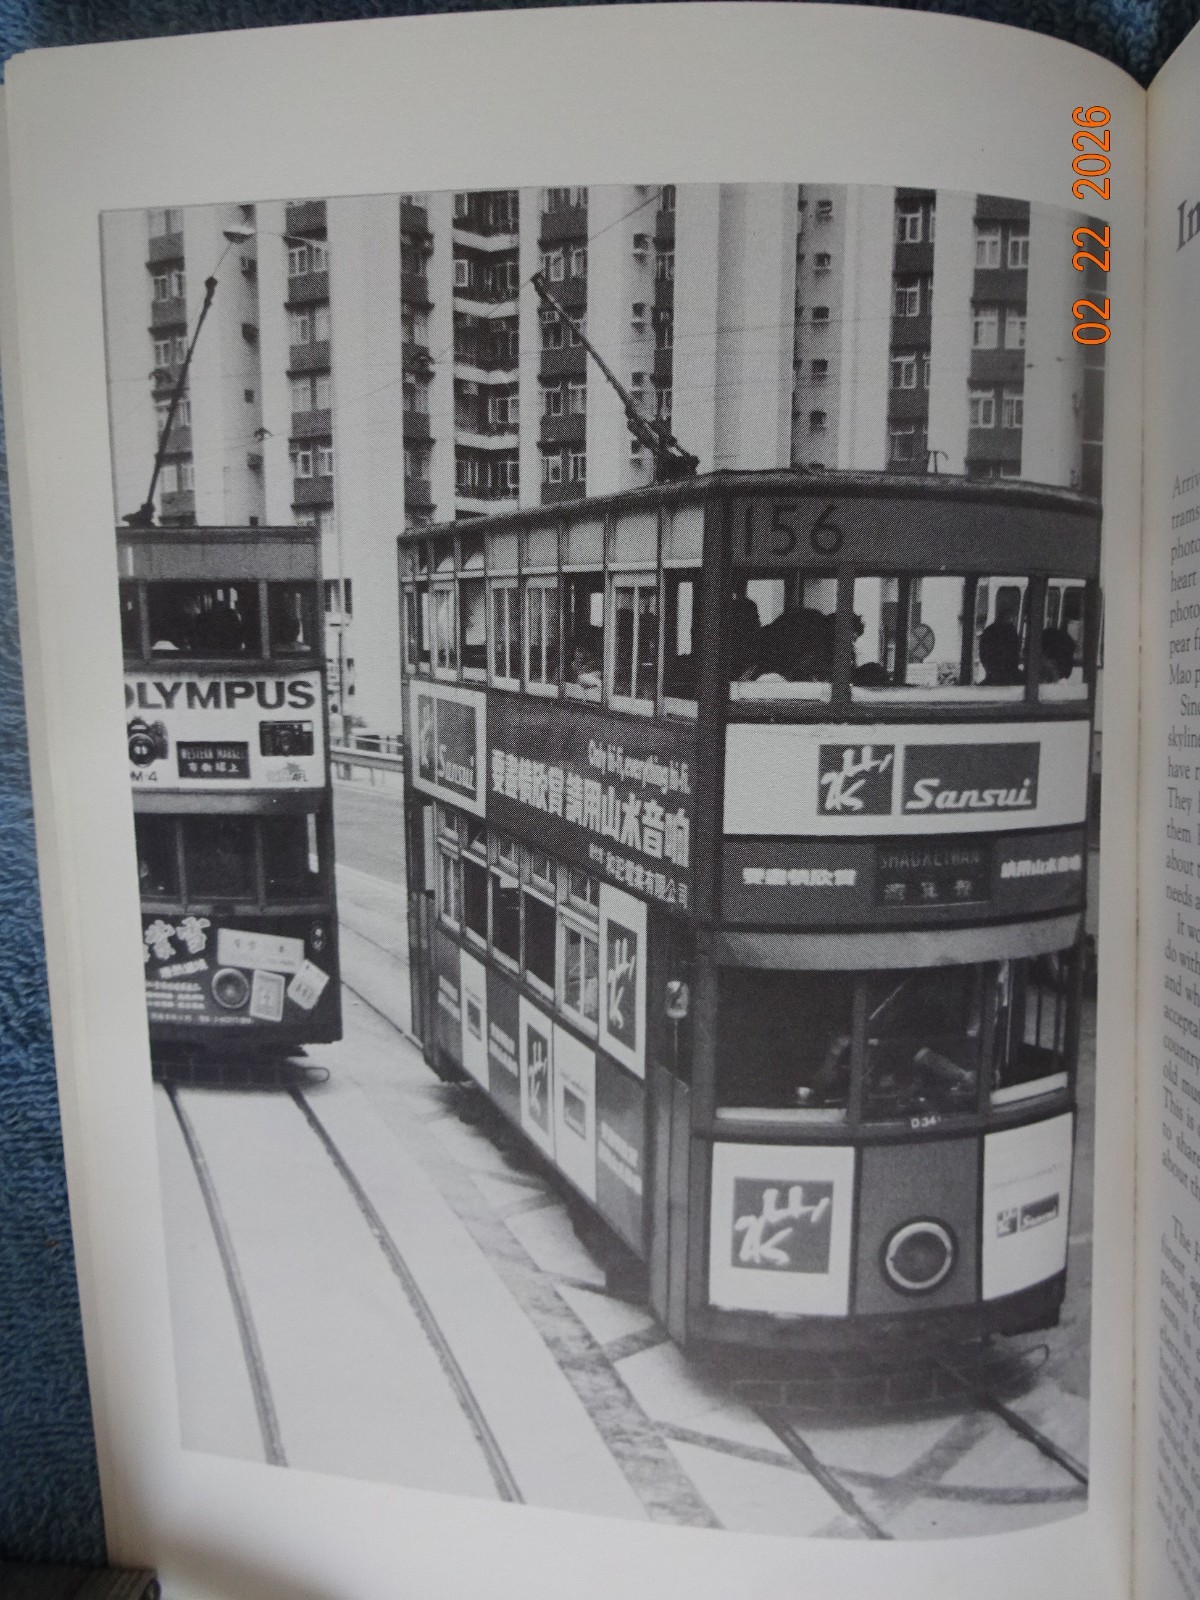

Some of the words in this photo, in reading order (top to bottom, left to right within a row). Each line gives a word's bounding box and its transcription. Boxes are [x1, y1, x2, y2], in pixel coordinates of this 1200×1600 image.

[742, 504, 843, 556] 156
[1170, 570, 1197, 592] heart
[1170, 600, 1200, 628] photo
[1169, 638, 1190, 658] pear
[1169, 663, 1191, 684] Mao
[1167, 756, 1190, 779] have
[905, 778, 1032, 810] Sansui
[1167, 787, 1192, 816] They
[1166, 817, 1191, 843] them
[1165, 848, 1194, 877] about
[1164, 938, 1177, 962] do
[1163, 975, 1182, 996] and
[1163, 1005, 1200, 1041] accepta
[1162, 1060, 1178, 1086] old
